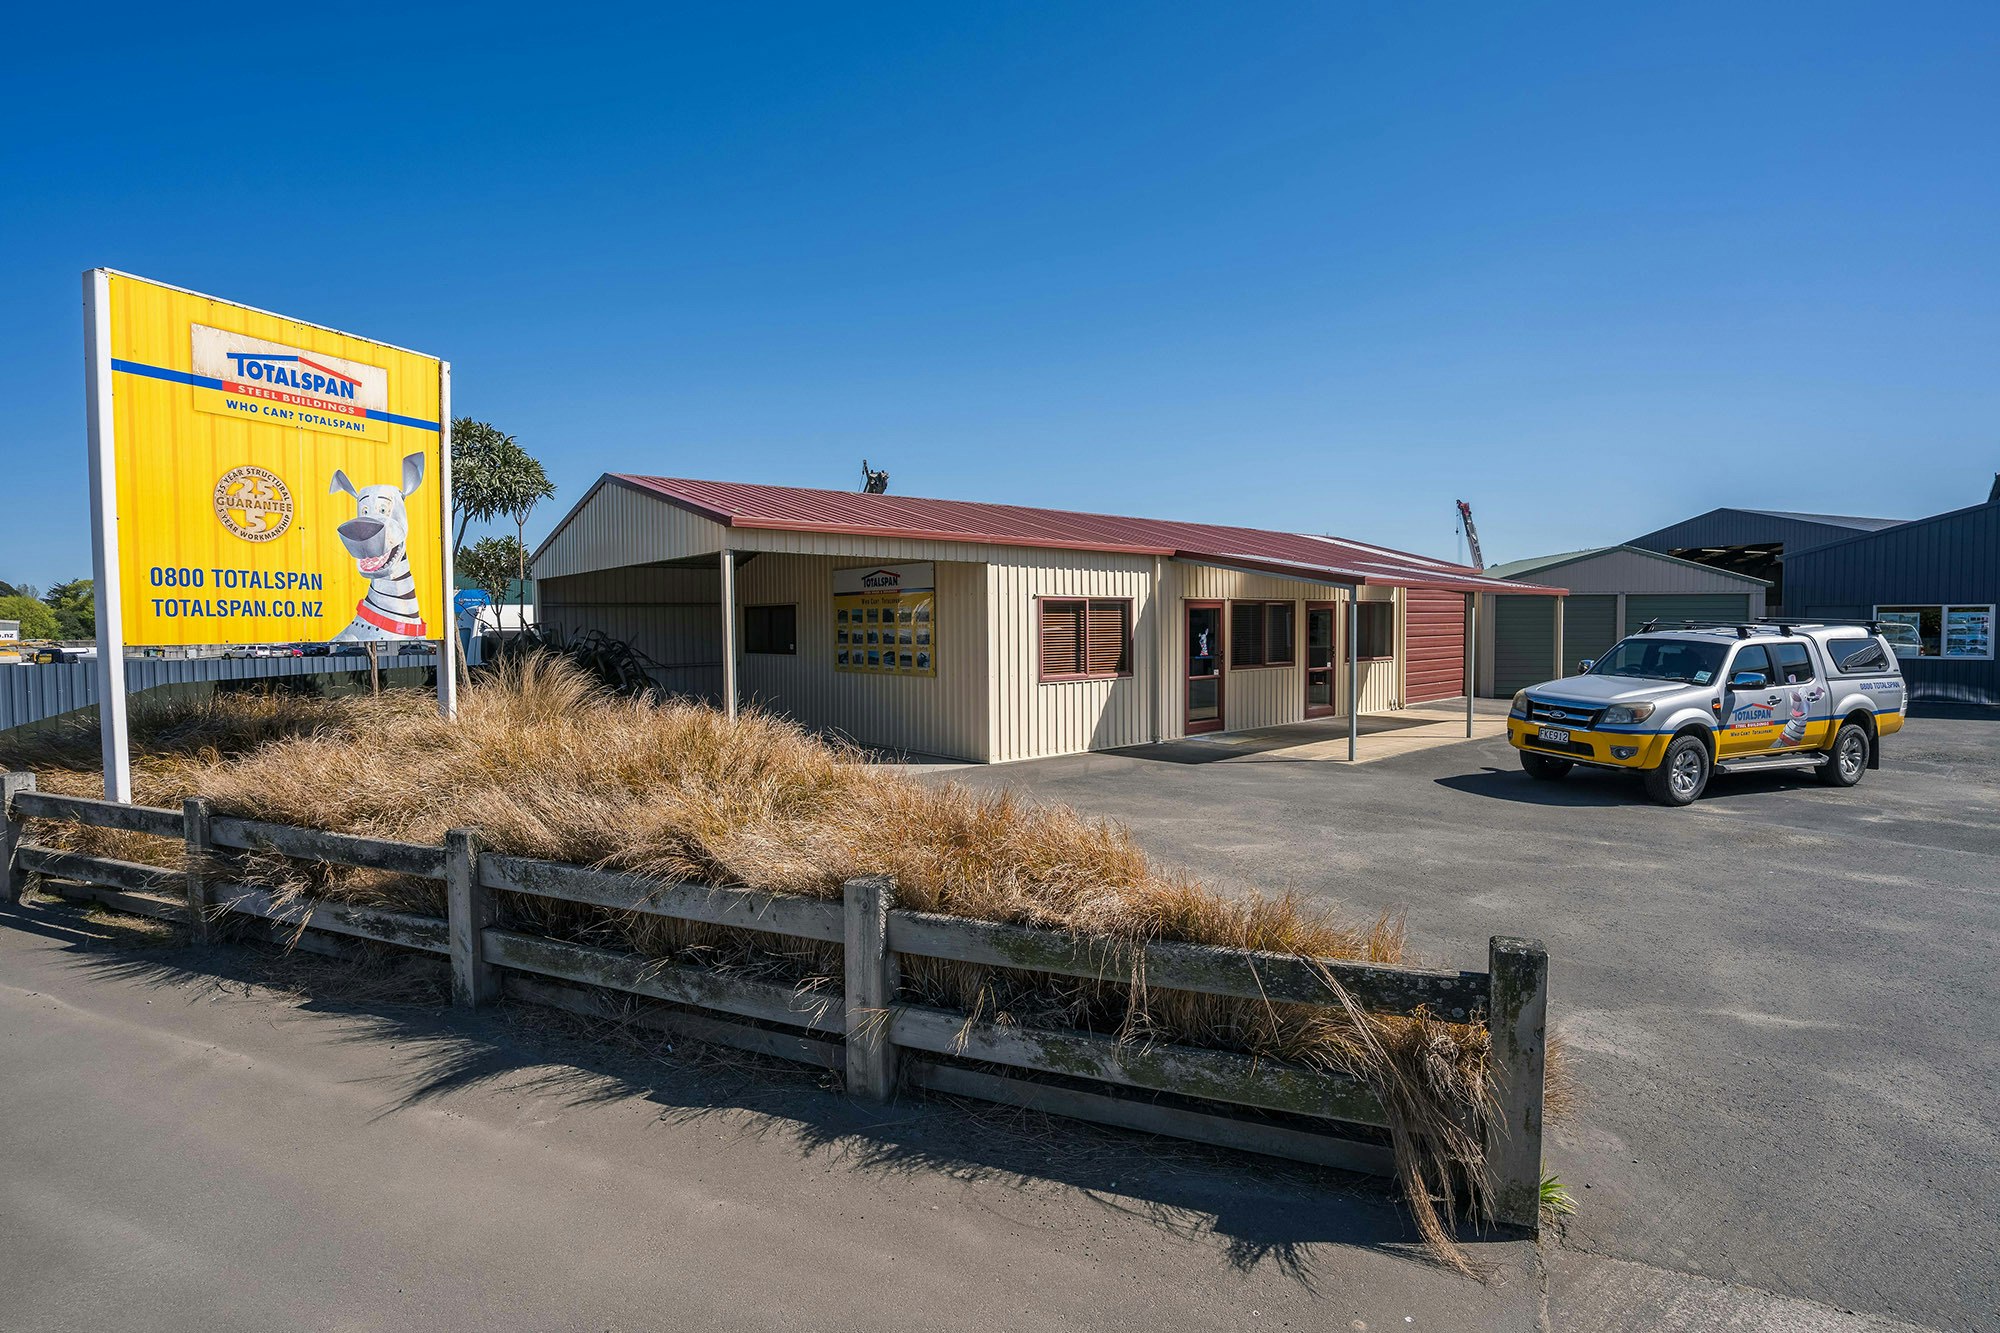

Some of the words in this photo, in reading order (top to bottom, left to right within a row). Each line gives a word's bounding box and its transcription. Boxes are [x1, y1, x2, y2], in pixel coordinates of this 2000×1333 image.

[226, 352, 355, 399] TOTALSPAN
[238, 385, 278, 400] STEEL
[283, 394, 355, 415] BUILDINGS
[226, 399, 258, 413] WHO
[263, 406, 294, 420] CAN?
[298, 412, 365, 432] TOTALSPAN!
[217, 485, 226, 494] 25
[223, 469, 244, 484] YEAR
[246, 467, 290, 501] STRUCTURAL
[216, 496, 292, 513] GUARANTEE
[221, 514, 239, 533] YEAR
[240, 514, 290, 541] WORKMANSHIP
[150, 566, 204, 588] 0800
[211, 569, 322, 591] TOTALSPAN
[862, 573, 899, 588] TOTALSPAN
[151, 598, 323, 618] TOTALSPAN.CO.NZ
[1732, 707, 1772, 721] TOTALSPAN
[1540, 728, 1568, 742] FKE912
